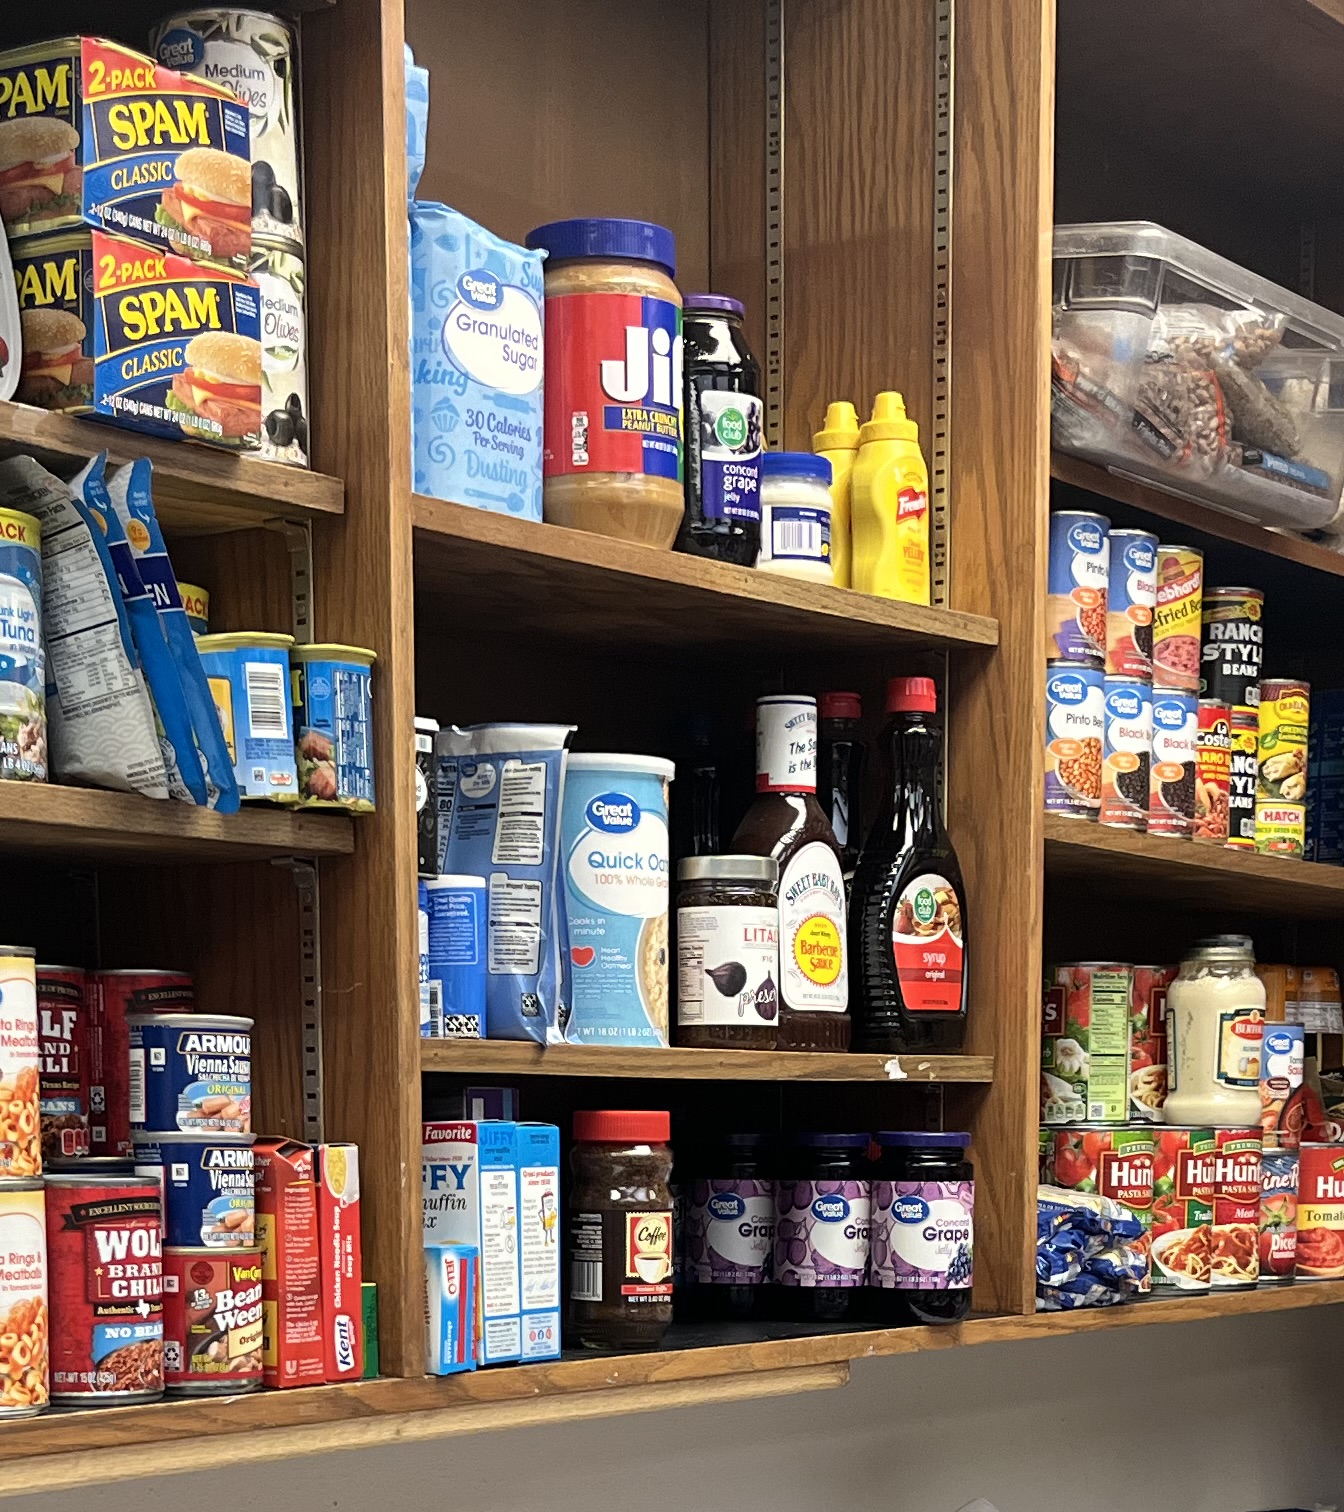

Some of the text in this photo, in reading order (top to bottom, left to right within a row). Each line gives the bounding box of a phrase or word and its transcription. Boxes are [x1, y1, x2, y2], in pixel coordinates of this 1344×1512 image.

[88, 60, 156, 94] 2-PACK
[205, 64, 265, 82] Medium
[108, 100, 211, 151] SPAM
[111, 160, 173, 191] CLASSIC
[99, 255, 166, 287] 2-PACK
[462, 277, 497, 297] Great
[119, 287, 221, 340] SPAM
[264, 314, 299, 344] Olives
[456, 314, 538, 350] Granulated
[121, 349, 183, 380] CLASSIC
[502, 346, 538, 371] Sugar
[465, 408, 532, 442] 30 Calories
[464, 449, 528, 491] Dusting
[723, 475, 757, 493] grape
[1, 619, 35, 642] Tuna
[1066, 712, 1090, 725] Pinto
[1119, 727, 1144, 739] Black
[1163, 738, 1188, 749] Black
[592, 802, 632, 819] Great
[594, 873, 654, 887] 100% Whole
[785, 872, 831, 903] SWEET BABY
[801, 939, 838, 959] Barbecue
[922, 952, 946, 966] syrup
[810, 956, 833, 971] Sauce
[186, 1055, 227, 1075] Vienna
[425, 1125, 472, 1141] Favorite
[210, 1170, 244, 1190] Vienna
[1234, 1207, 1255, 1219] Meat
[637, 1226, 667, 1246] Coffee
[923, 1227, 969, 1244] Grape
[9, 1253, 35, 1267] Rings
[338, 1321, 351, 1367] Kent
